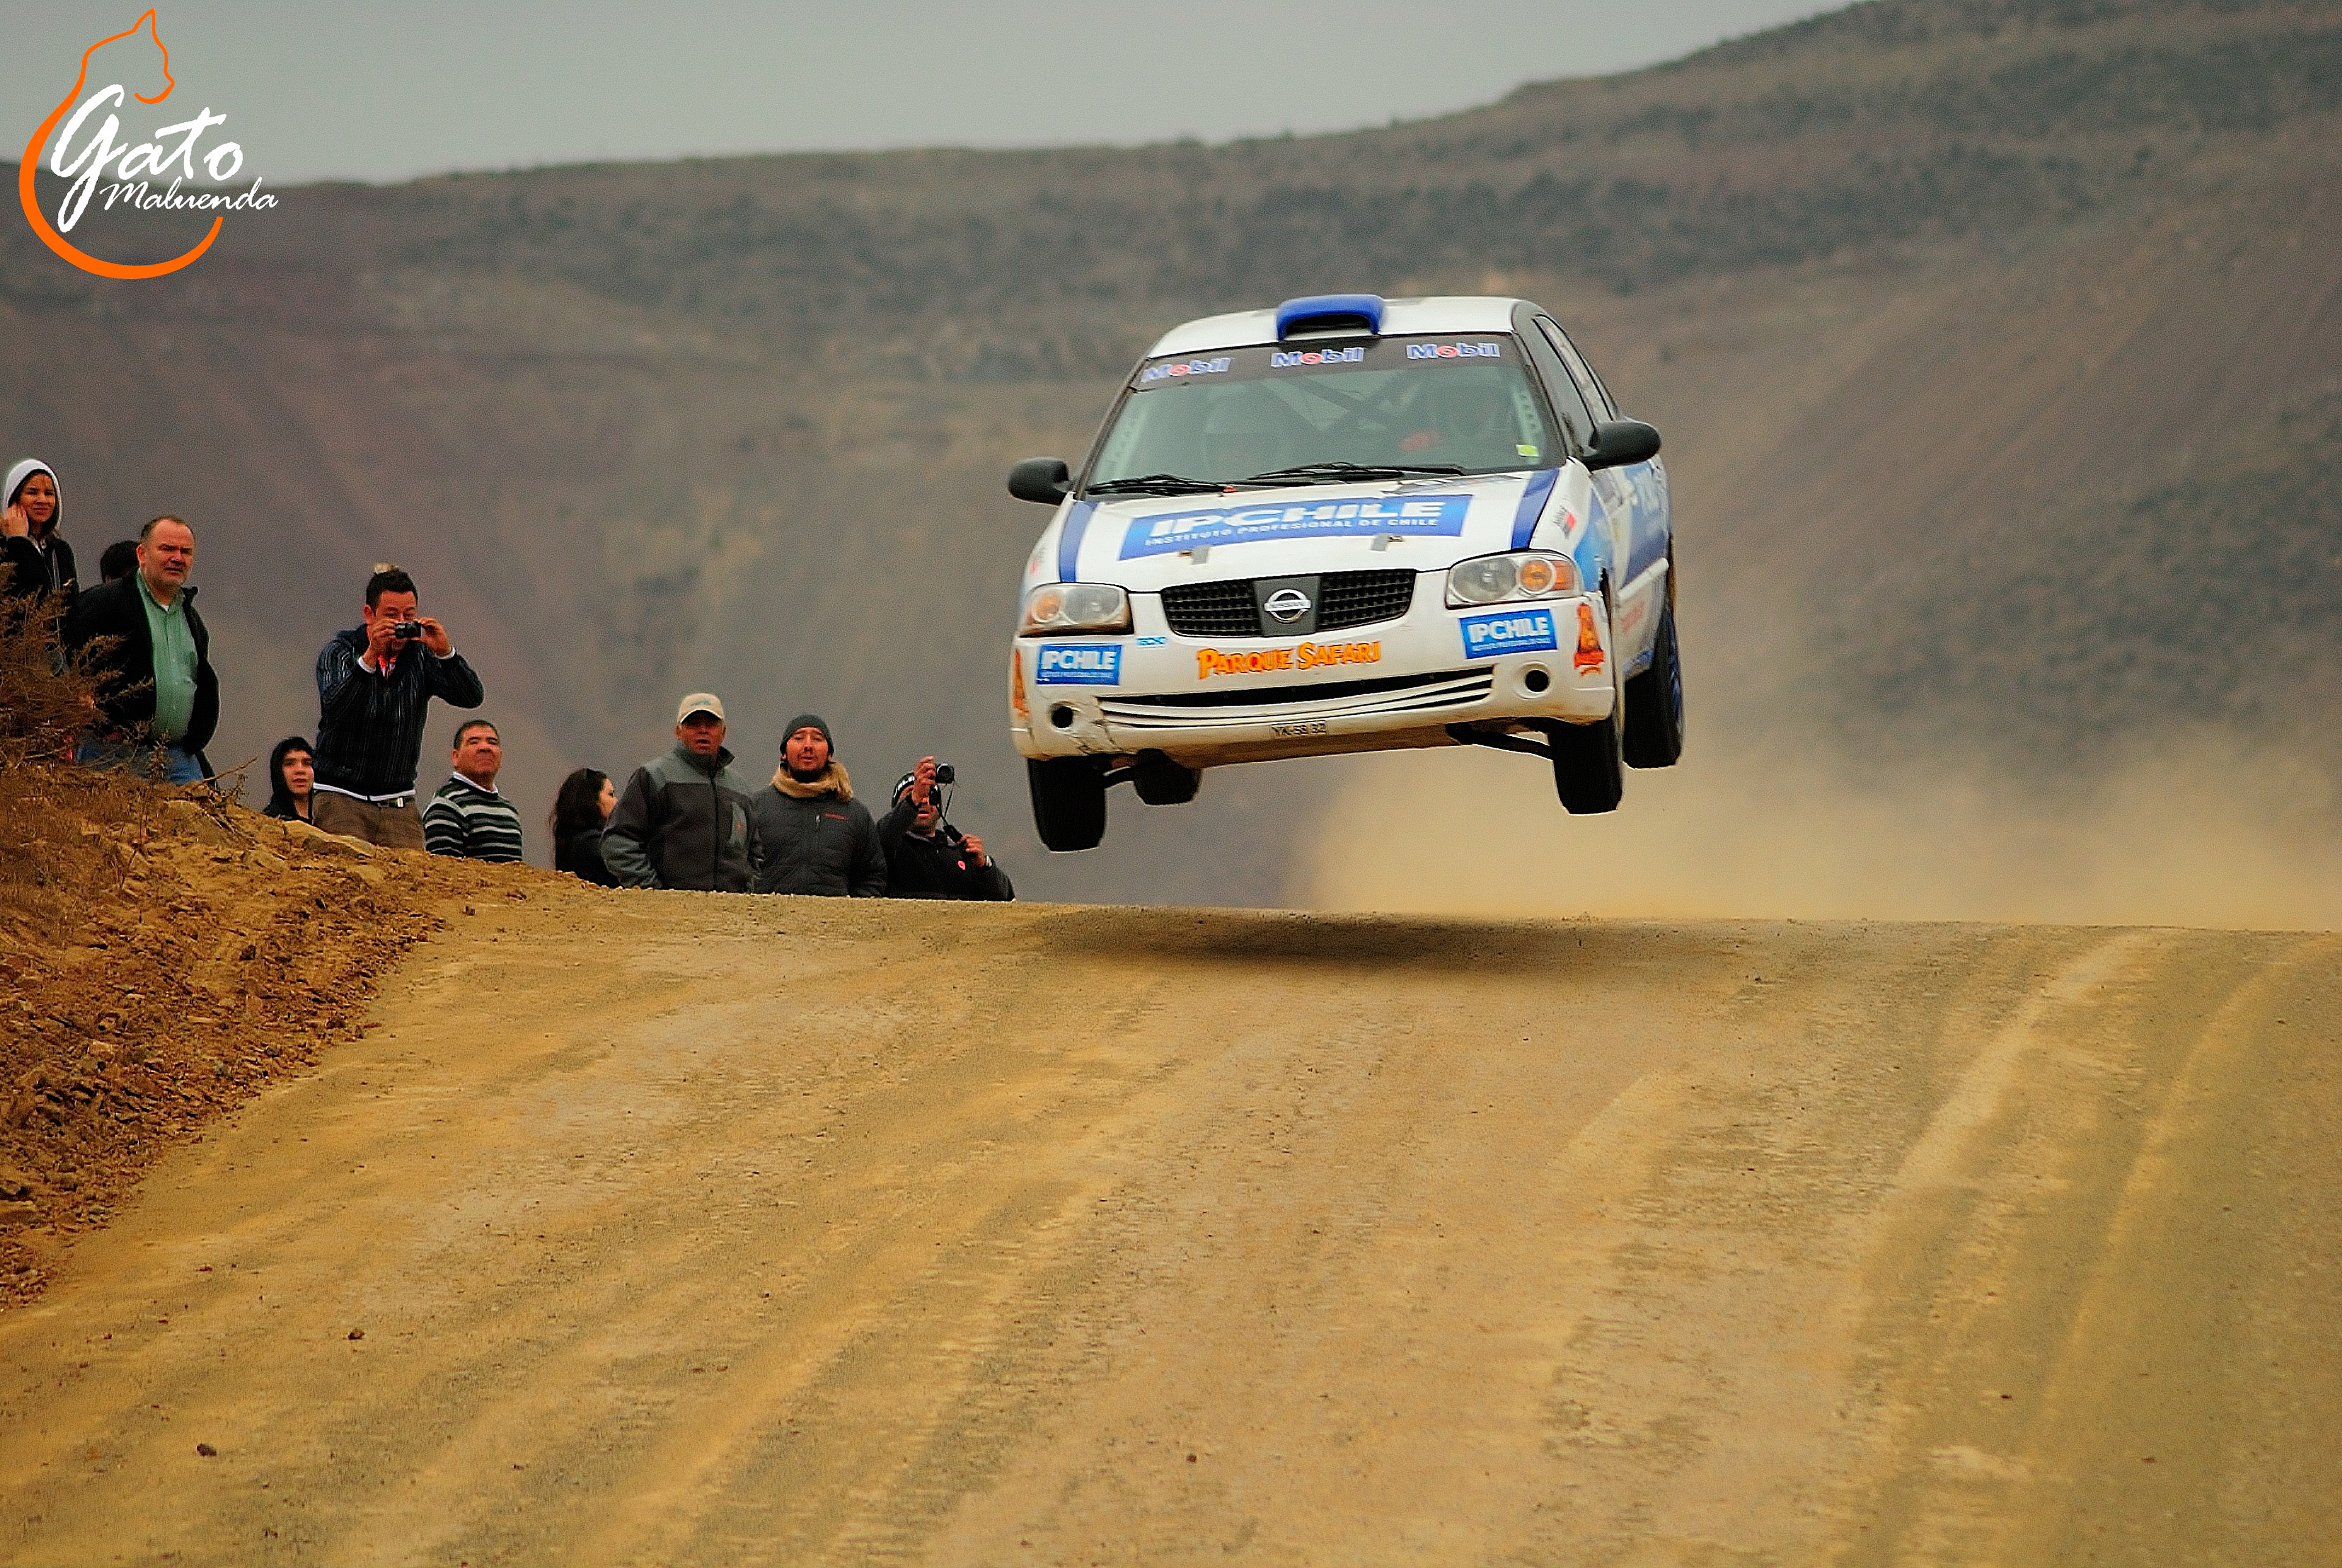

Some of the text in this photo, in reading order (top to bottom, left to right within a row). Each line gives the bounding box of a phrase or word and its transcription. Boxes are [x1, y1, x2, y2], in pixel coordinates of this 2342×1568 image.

[1270, 347, 1364, 368] Mobil
[1406, 343, 1500, 360] Mobil
[1141, 357, 1231, 383] Mobil
[1150, 501, 1446, 537] IPCHILE
[1145, 529, 1231, 546] INSTITUTO
[1237, 520, 1352, 535] PROFESIONAL
[1467, 617, 1551, 643] IPCHILE
